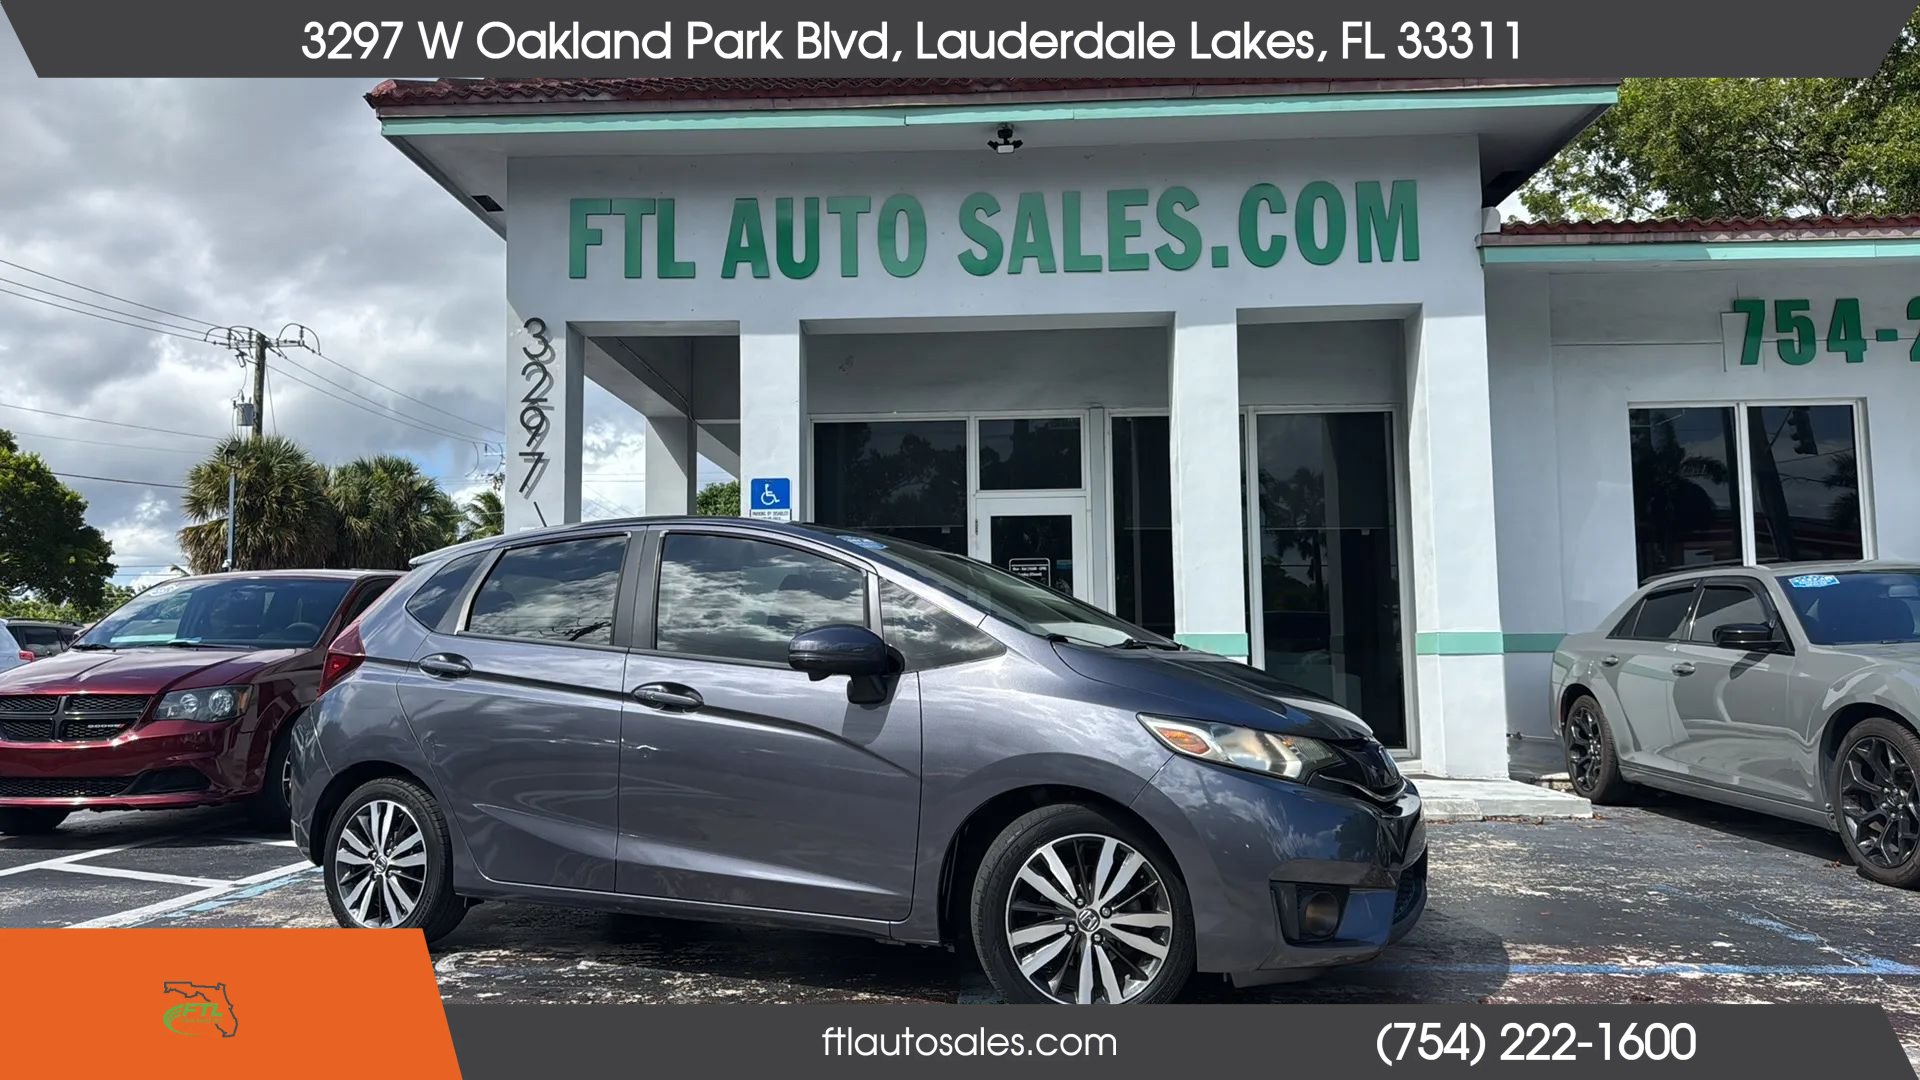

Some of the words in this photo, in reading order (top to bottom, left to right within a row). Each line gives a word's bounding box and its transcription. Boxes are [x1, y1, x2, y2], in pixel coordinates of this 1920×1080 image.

[570, 199, 696, 279] FTL
[721, 197, 927, 280] AUTO
[959, 181, 1421, 277] SALES.COM
[1733, 297, 1920, 366] 754-
[518, 316, 550, 493] 3297
